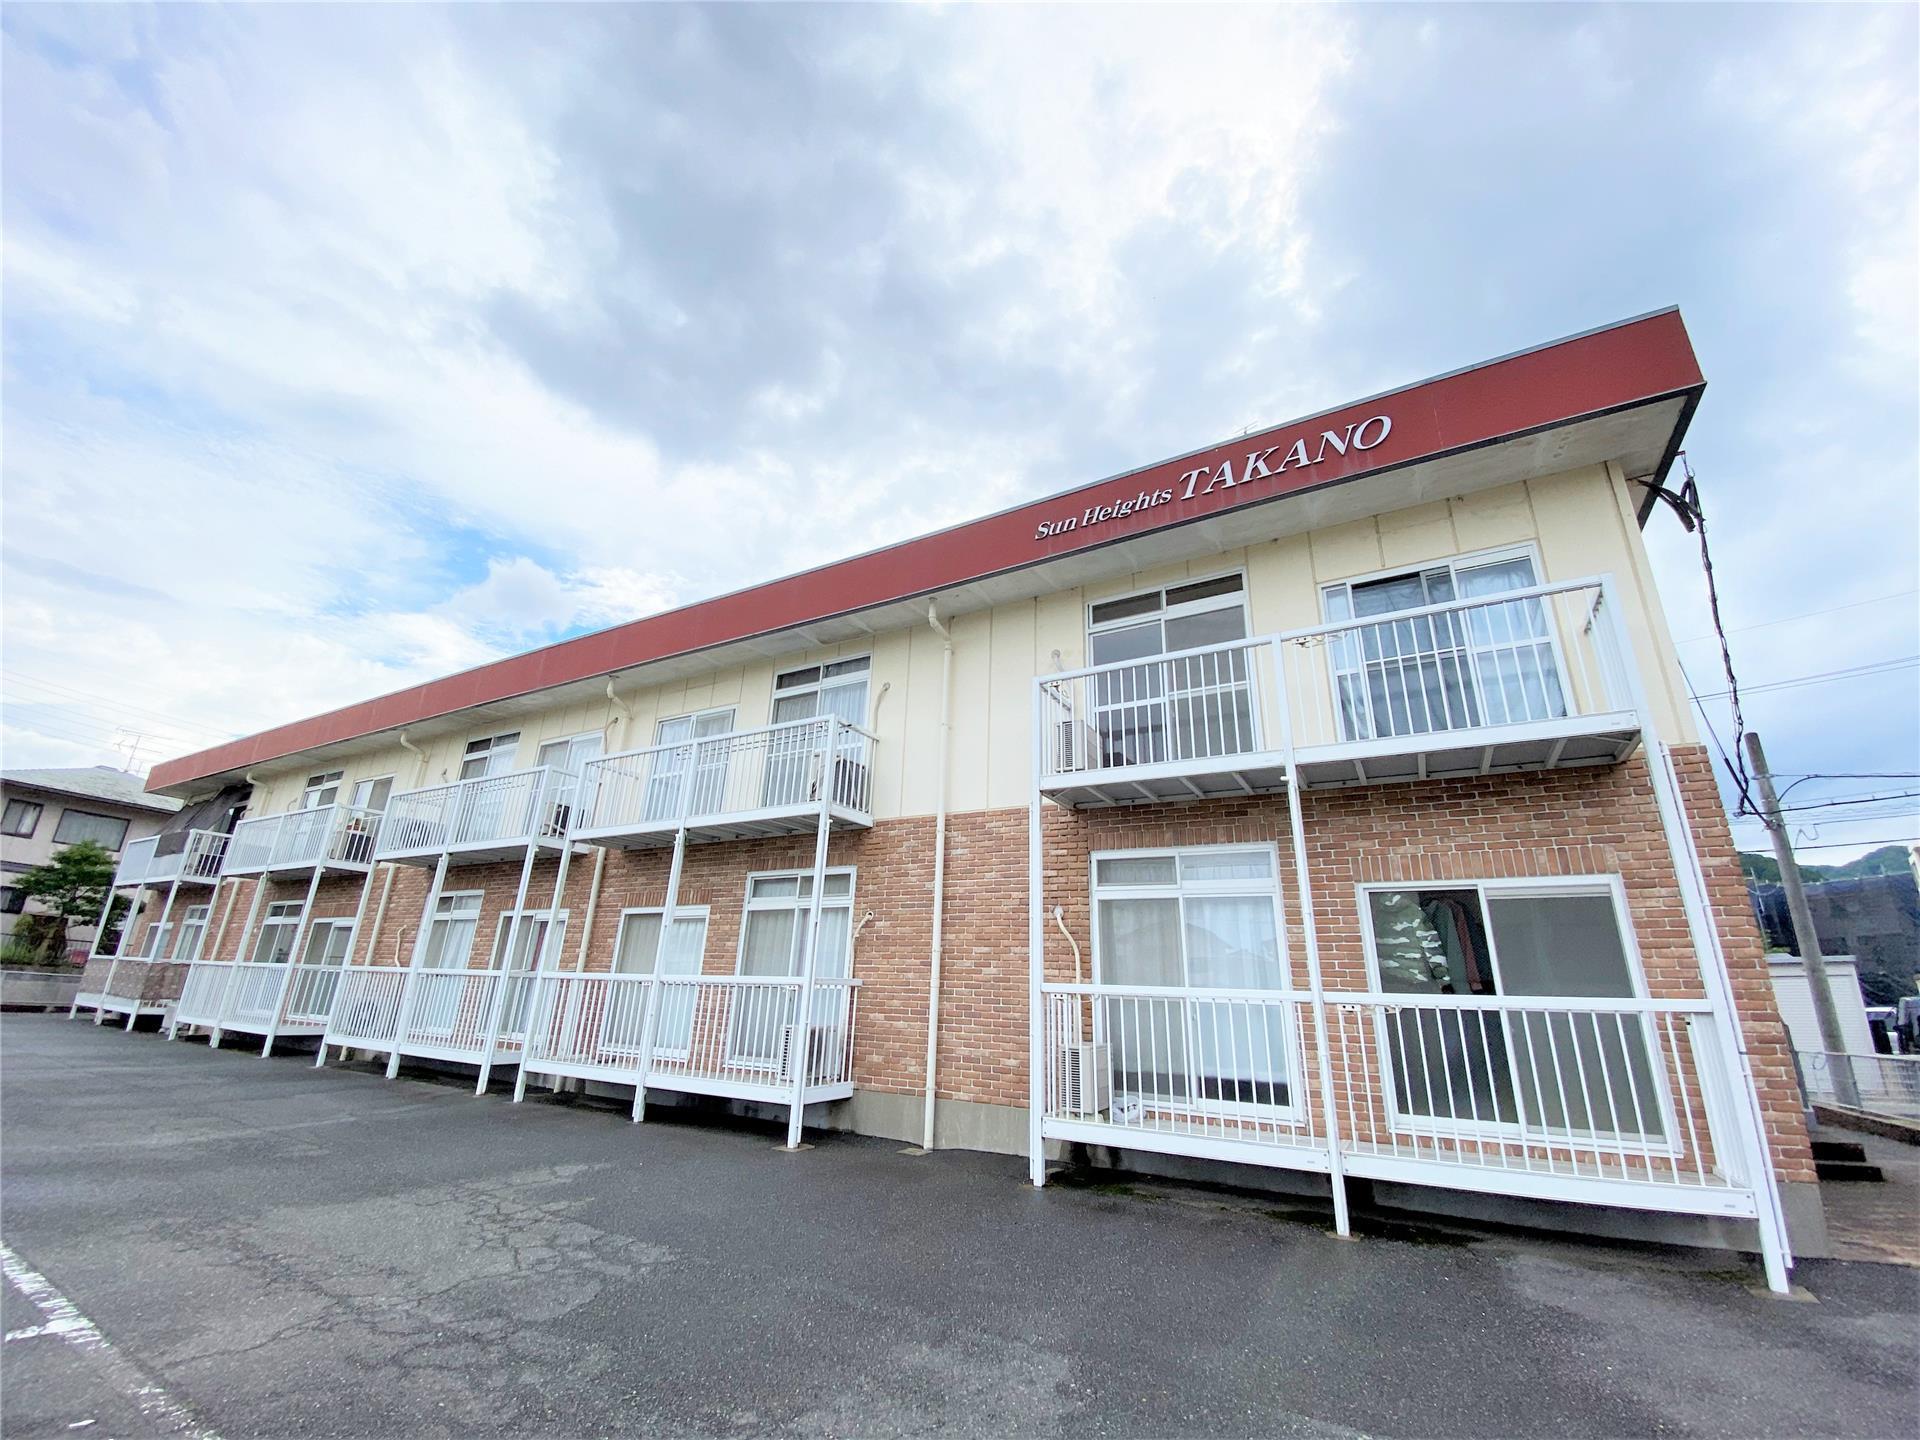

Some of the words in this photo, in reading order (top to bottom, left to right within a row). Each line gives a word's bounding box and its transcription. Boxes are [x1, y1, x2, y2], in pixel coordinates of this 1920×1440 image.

[1034, 517, 1077, 541] Sun
[1082, 488, 1172, 526] Heights
[1178, 415, 1392, 501] TAKANO
